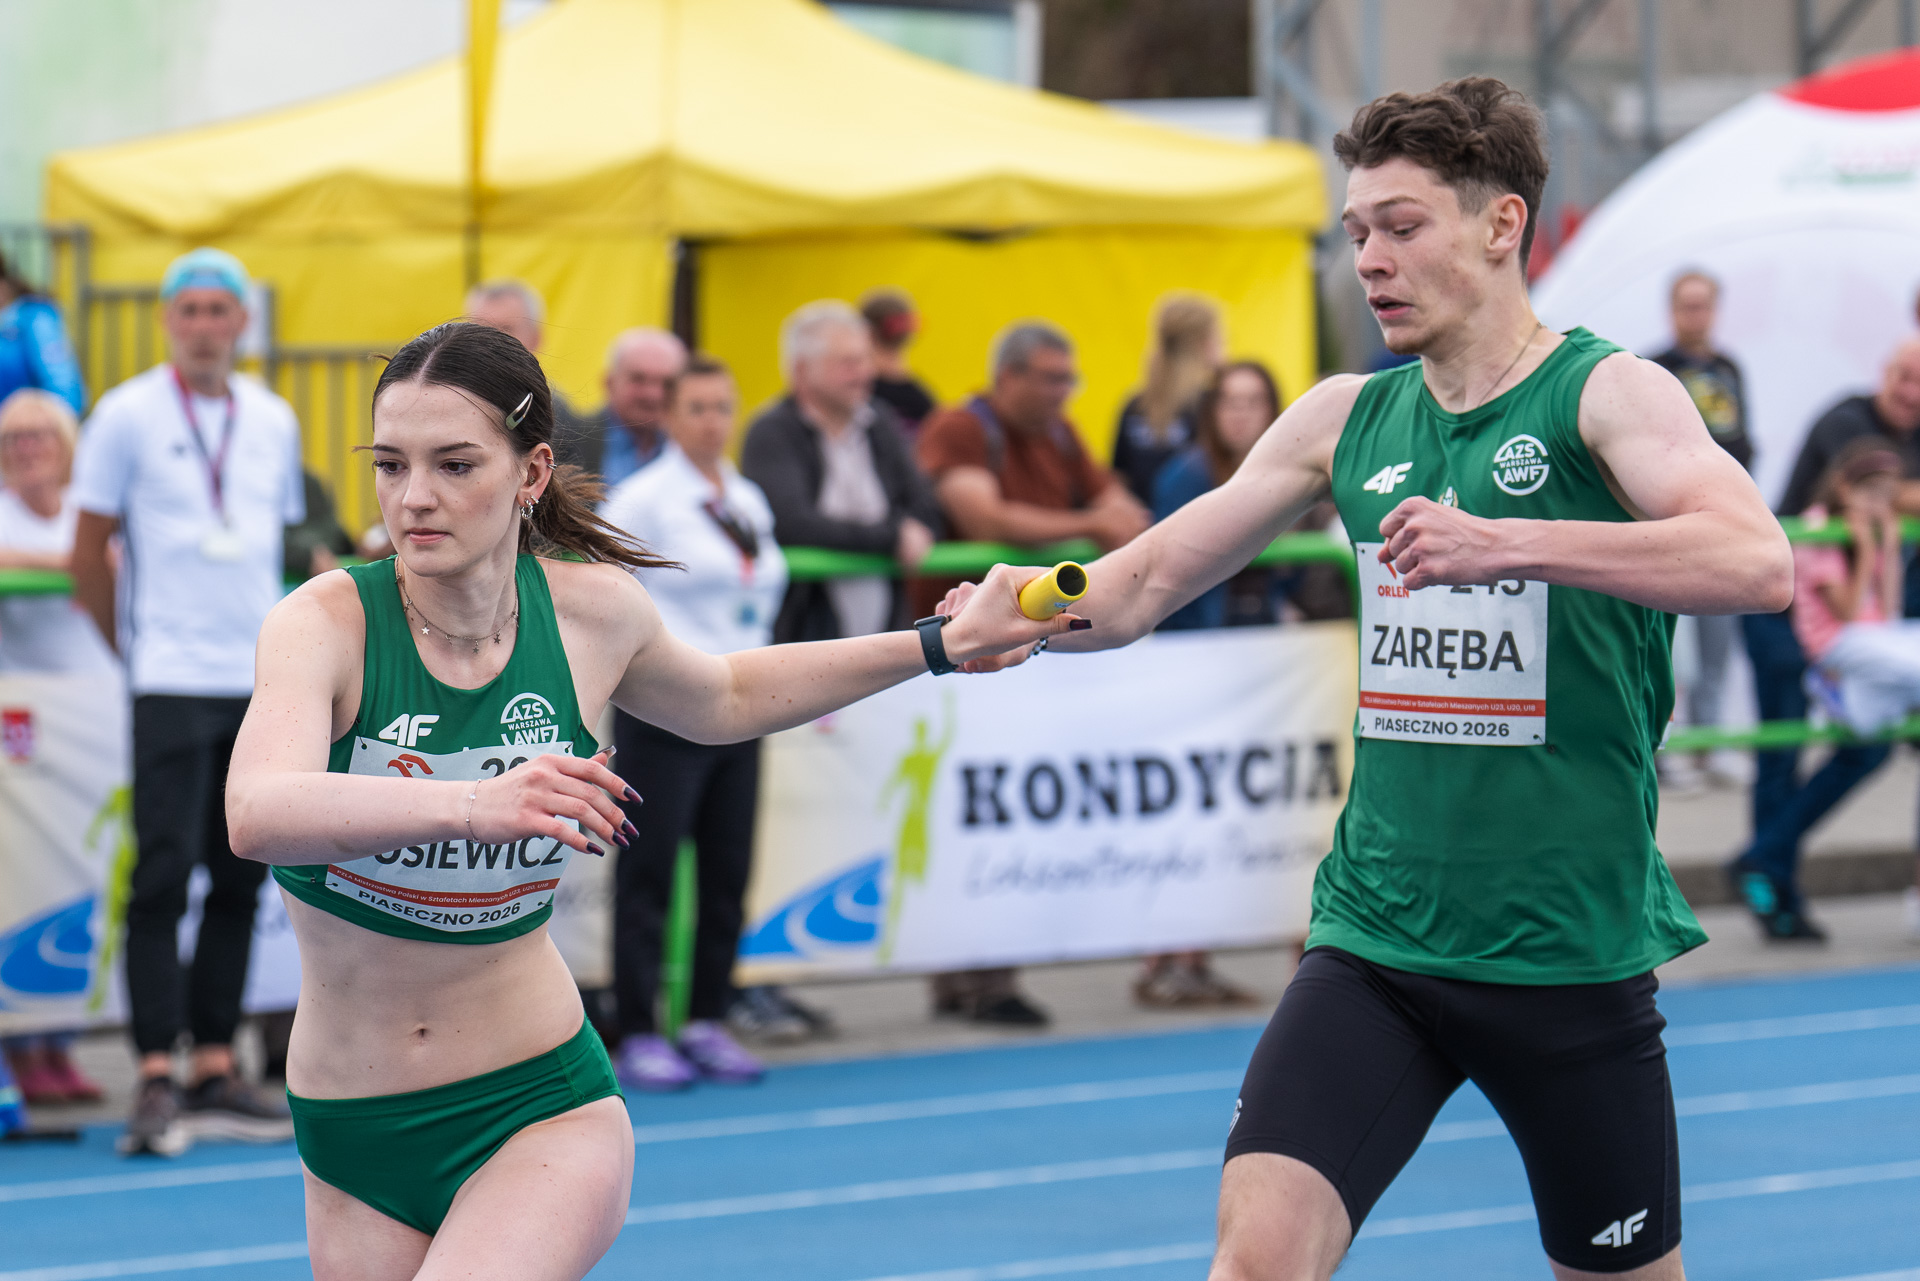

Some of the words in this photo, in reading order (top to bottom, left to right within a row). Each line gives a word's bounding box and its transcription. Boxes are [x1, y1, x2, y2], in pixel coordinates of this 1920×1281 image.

[1505, 443, 1536, 461] AZS
[1500, 457, 1543, 468] WARSZAWA
[1363, 462, 1413, 494] 4F
[1503, 465, 1540, 484] AWF
[1371, 624, 1525, 679] ZARĘBA
[512, 702, 544, 721] AZS
[1449, 701, 1489, 711] Mieszanych
[378, 713, 440, 747] 4F
[507, 718, 552, 731] WARSZAWA
[1375, 717, 1458, 735] PIASECZNO
[1463, 721, 1510, 737] 2026
[513, 727, 551, 746] AWF
[398, 890, 419, 900] Polski
[428, 896, 467, 904] Sztafetach
[358, 890, 474, 925] PIASECZNO
[478, 902, 521, 924] 2026
[1591, 1208, 1648, 1248] 4F
